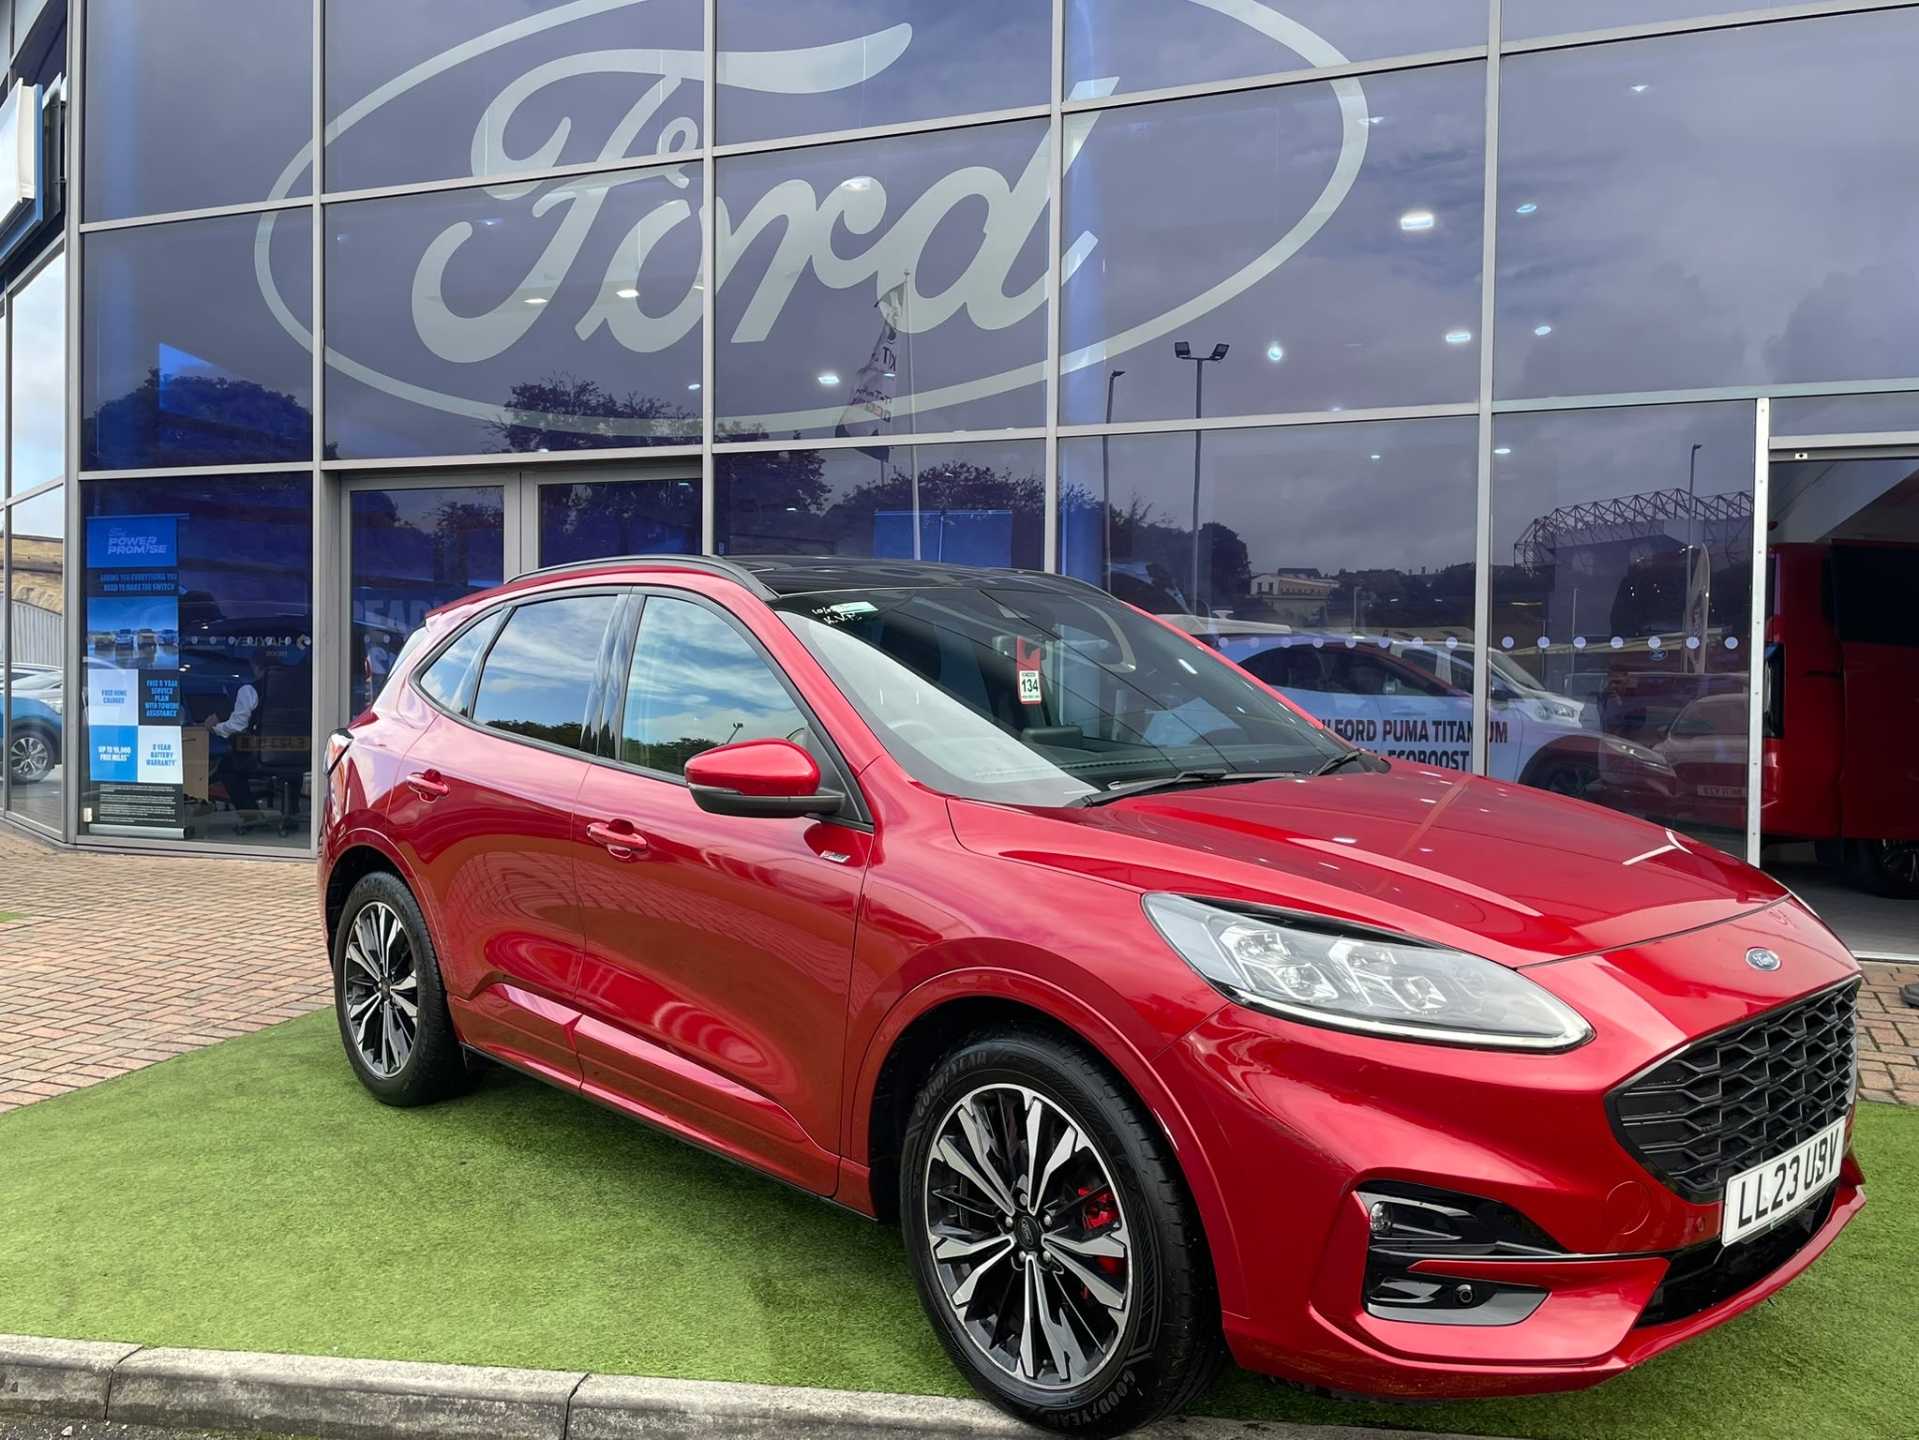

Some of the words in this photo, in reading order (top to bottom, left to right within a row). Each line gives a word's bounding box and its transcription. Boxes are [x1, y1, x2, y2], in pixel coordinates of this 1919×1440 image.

[412, 22, 1119, 363] Ford
[107, 544, 167, 555] PROMISE
[109, 536, 157, 546] POWER
[1021, 678, 1038, 693] 134
[1335, 719, 1377, 742] FORD
[1382, 719, 1430, 743] PUMA
[1737, 1154, 1801, 1230] LL23
